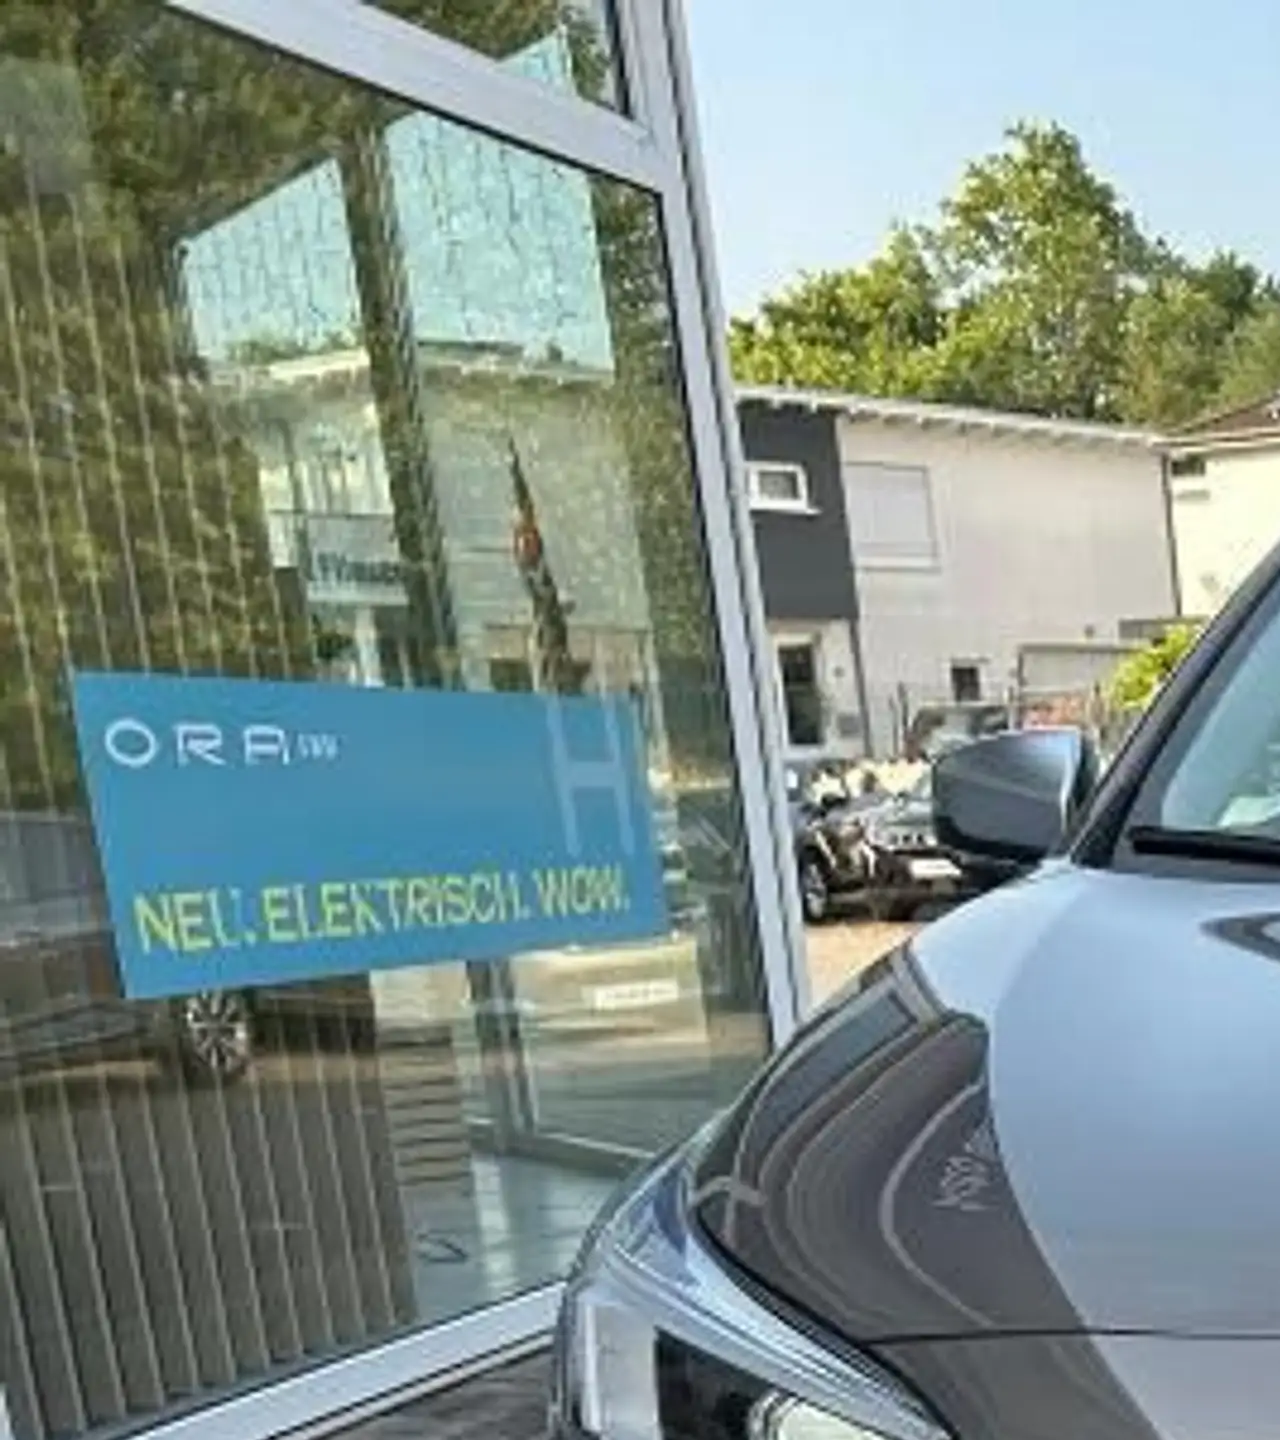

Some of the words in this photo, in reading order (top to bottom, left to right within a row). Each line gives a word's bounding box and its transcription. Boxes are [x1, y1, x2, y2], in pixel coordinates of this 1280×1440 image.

[103, 717, 290, 769] ORA
[260, 870, 530, 942] ELEKTRISCH.
[532, 864, 631, 918] WOW.
